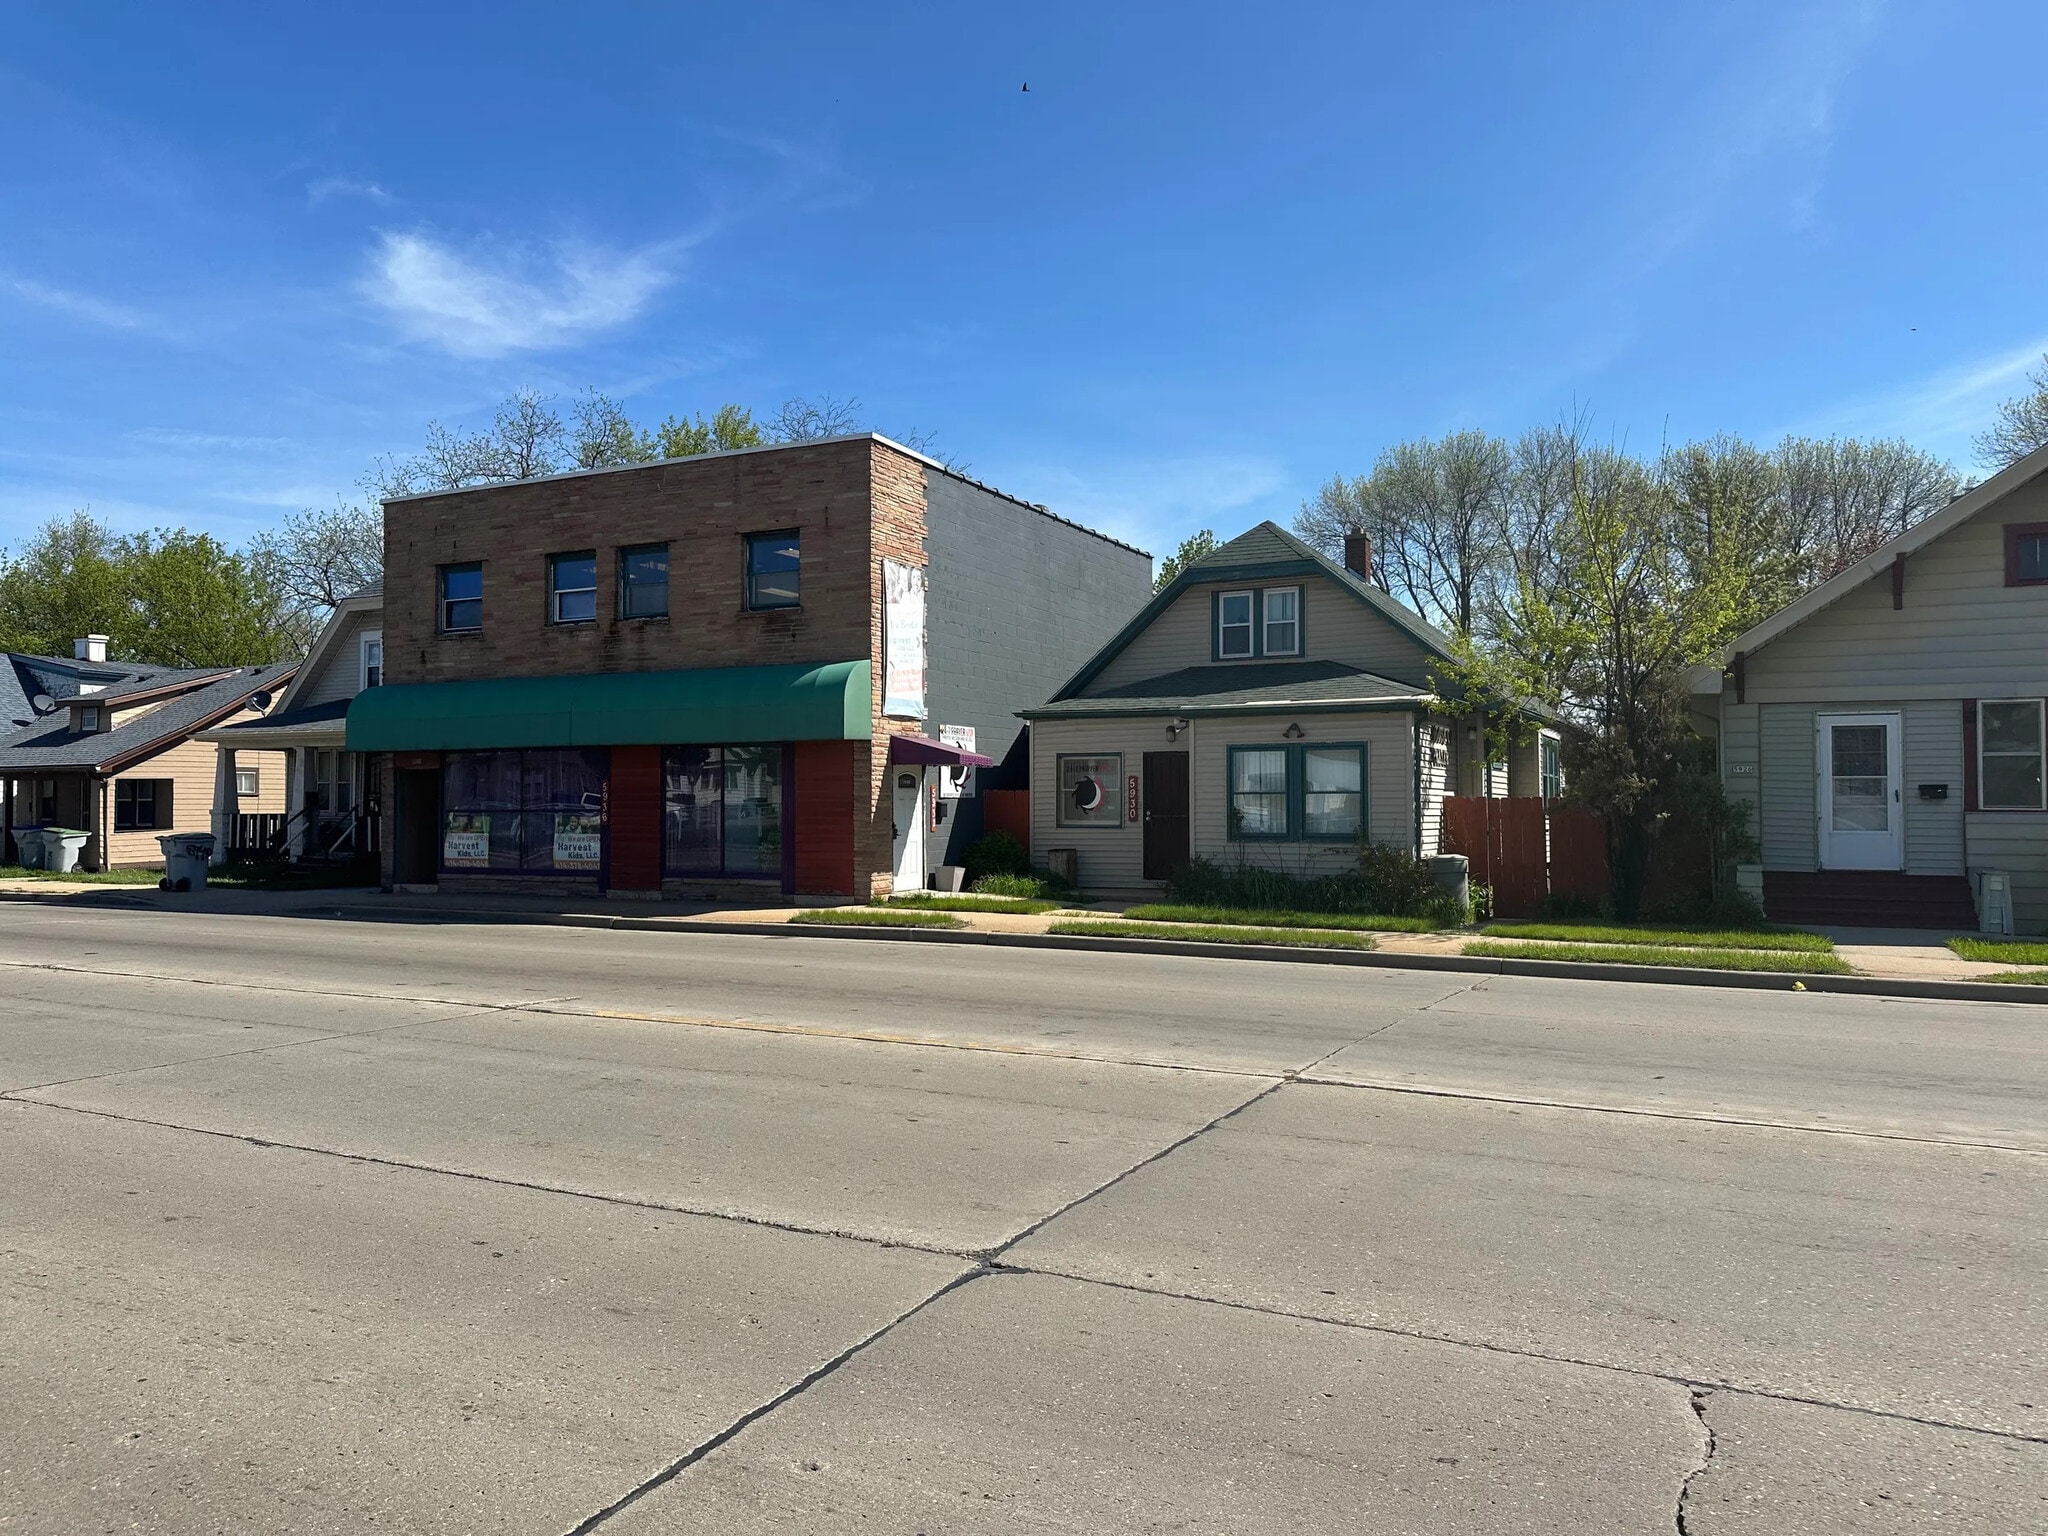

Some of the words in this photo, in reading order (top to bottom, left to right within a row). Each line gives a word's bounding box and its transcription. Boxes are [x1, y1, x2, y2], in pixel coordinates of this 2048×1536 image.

[448, 841, 479, 850] Harvest
[558, 842, 592, 852] Harvest
[568, 852, 585, 860] Kids,
